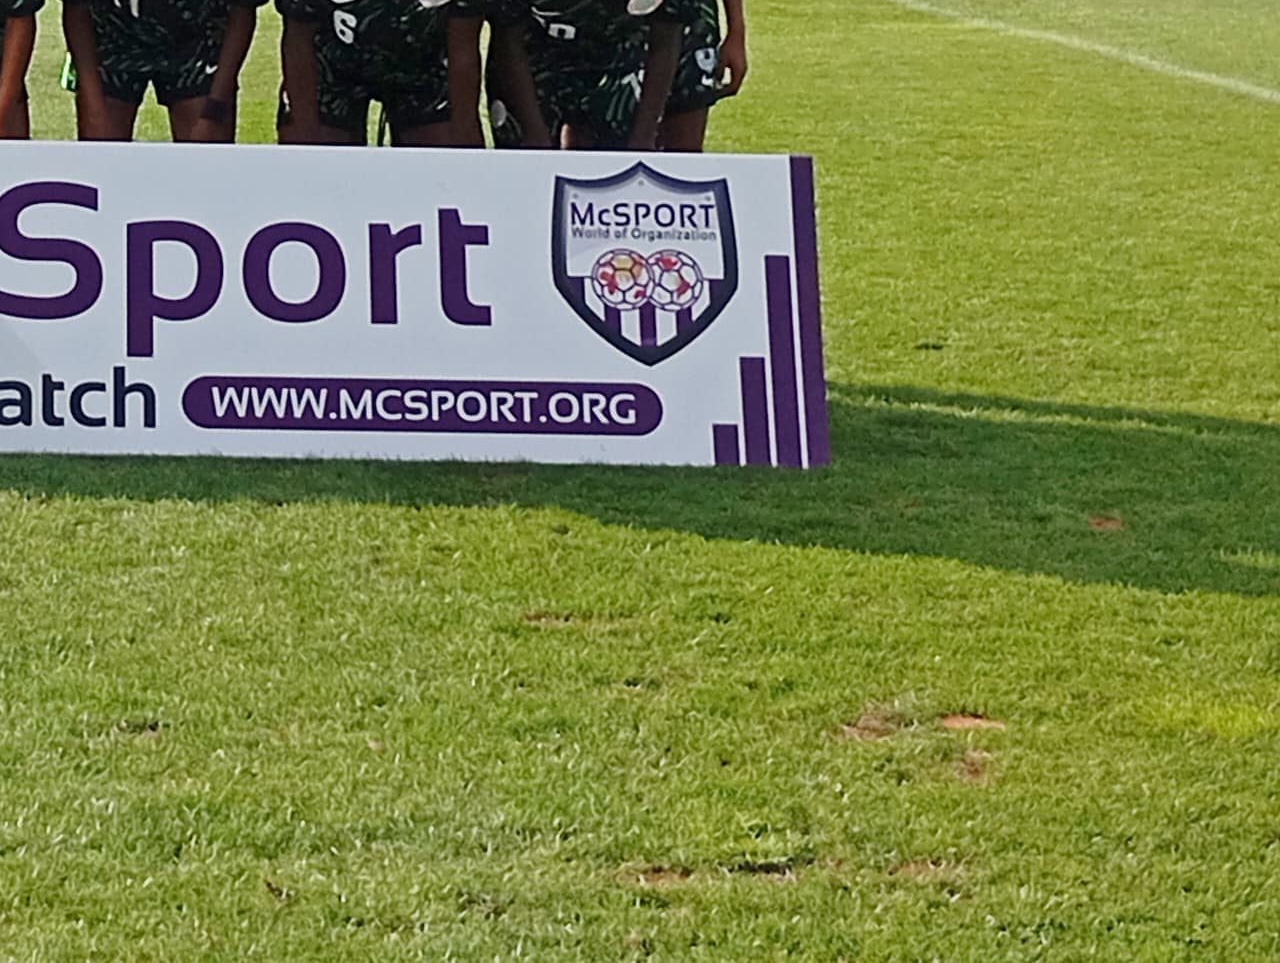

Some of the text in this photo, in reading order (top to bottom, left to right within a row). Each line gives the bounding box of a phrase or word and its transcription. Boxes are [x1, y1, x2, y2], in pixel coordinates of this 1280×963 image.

[333, 9, 357, 44] 6
[571, 202, 715, 228] McSPORT
[572, 226, 717, 243] World of Organization
[211, 386, 637, 425] WWW.MCSPORT.ORG
